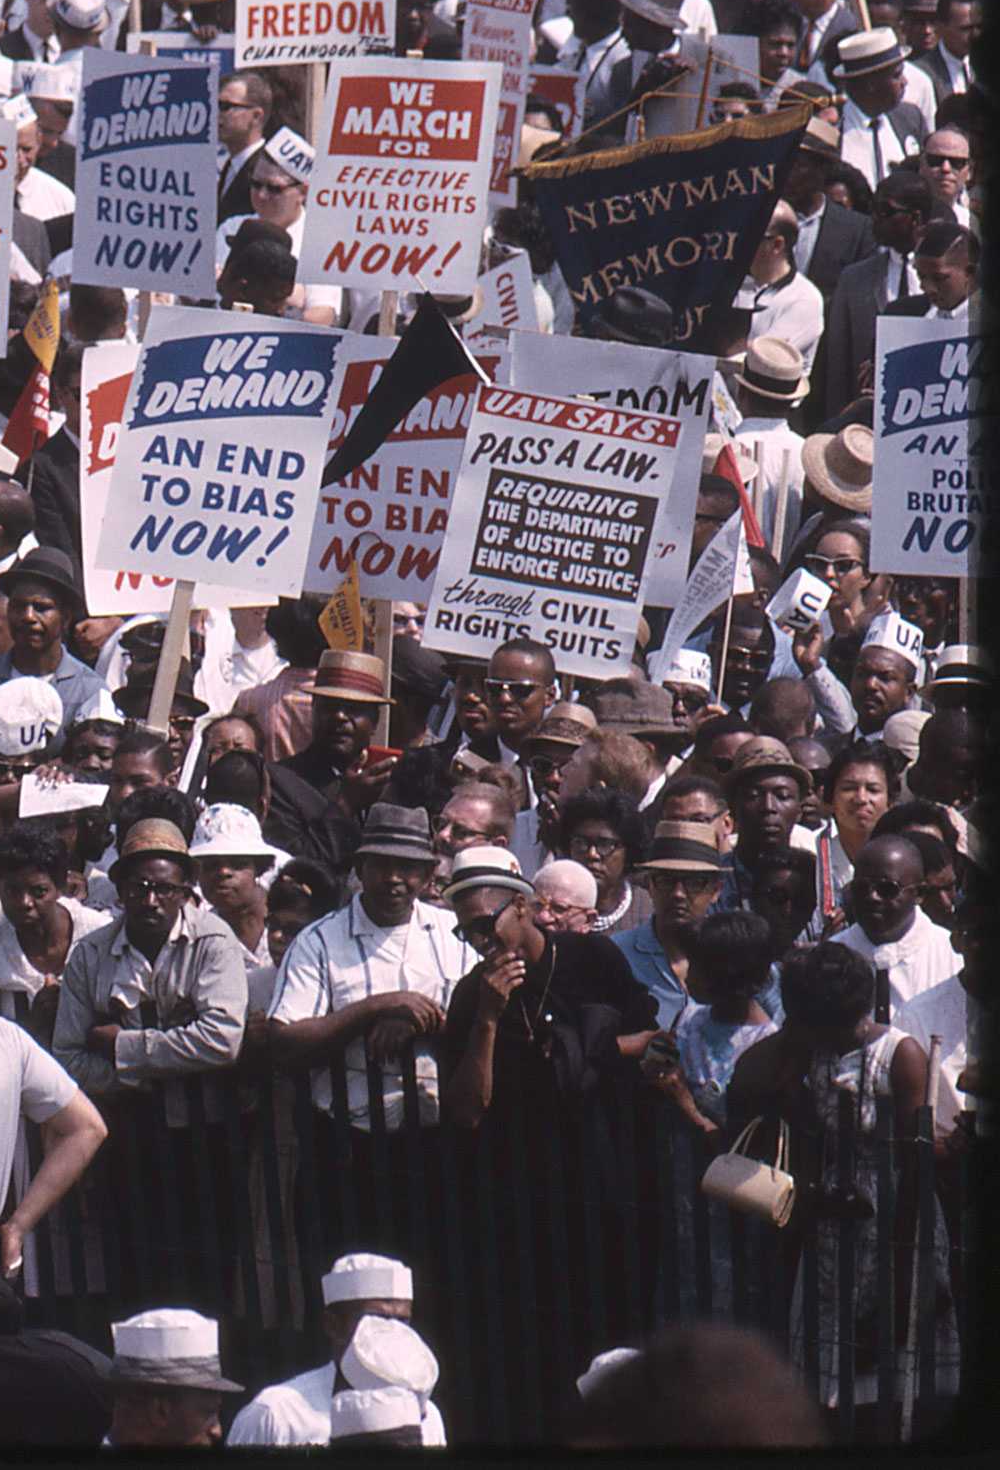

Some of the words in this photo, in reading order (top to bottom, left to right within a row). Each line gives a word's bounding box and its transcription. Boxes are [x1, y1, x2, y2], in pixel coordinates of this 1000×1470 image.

[247, 1, 386, 39] FREEDOM
[242, 41, 357, 62] CHATTANOOGA
[122, 74, 171, 107] WE
[389, 82, 435, 106] WE
[89, 102, 207, 150] DEMAND
[342, 107, 471, 140] MARCH
[379, 140, 430, 156] FOR
[100, 162, 195, 197] EQUAL
[336, 166, 470, 190] EFFECTIVE
[97, 197, 198, 232] RIGHTS
[316, 190, 379, 210] CIVIL
[389, 194, 477, 214] RIGHTS
[565, 163, 776, 233] NEWMAN
[356, 217, 428, 236] LAWS
[94, 235, 202, 276] NOW!
[322, 241, 461, 277] NOW!
[203, 336, 281, 374] WE
[144, 370, 325, 418] DEMAND
[484, 391, 565, 425] UAW
[566, 405, 677, 443] SAYS:
[142, 435, 204, 469] AN
[217, 443, 305, 481] END
[470, 432, 553, 470] PASS
[554, 440, 580, 469] A
[904, 434, 957, 455] AN
[142, 474, 191, 507] TO
[202, 482, 295, 520] BIAS
[494, 478, 639, 519] REQUIRING
[130, 515, 290, 567] NOW!
[488, 500, 522, 522] THE
[524, 508, 644, 545] DEPARTMENT
[476, 548, 558, 581] ENFORCE
[483, 525, 510, 546] OF
[514, 532, 593, 562] JUSTICE
[603, 546, 630, 567] TO
[444, 578, 535, 618] through
[540, 599, 616, 631] CIVIL
[434, 609, 531, 642] RIGHTS
[544, 630, 622, 662] SUITS
